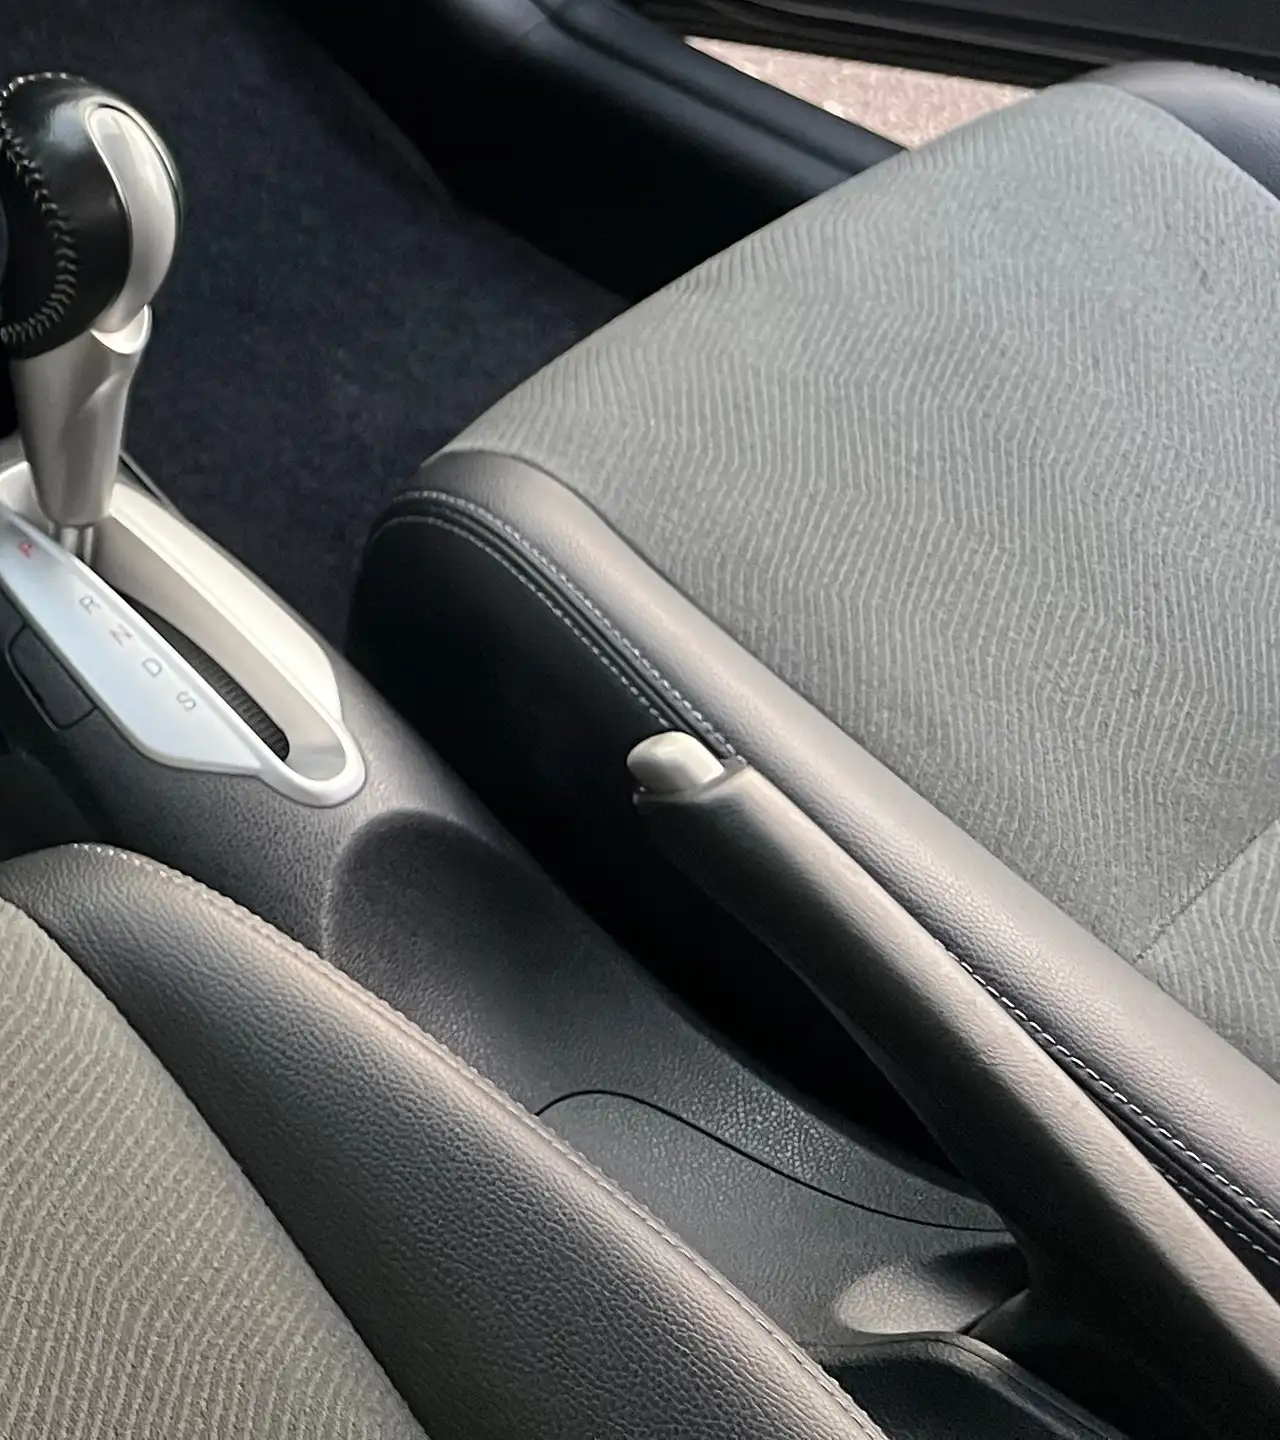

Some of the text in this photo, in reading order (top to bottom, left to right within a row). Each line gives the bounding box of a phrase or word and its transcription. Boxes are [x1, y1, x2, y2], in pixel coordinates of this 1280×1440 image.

[78, 595, 101, 615] R
[109, 623, 133, 646] N
[142, 657, 163, 678] D
[176, 691, 197, 712] S
